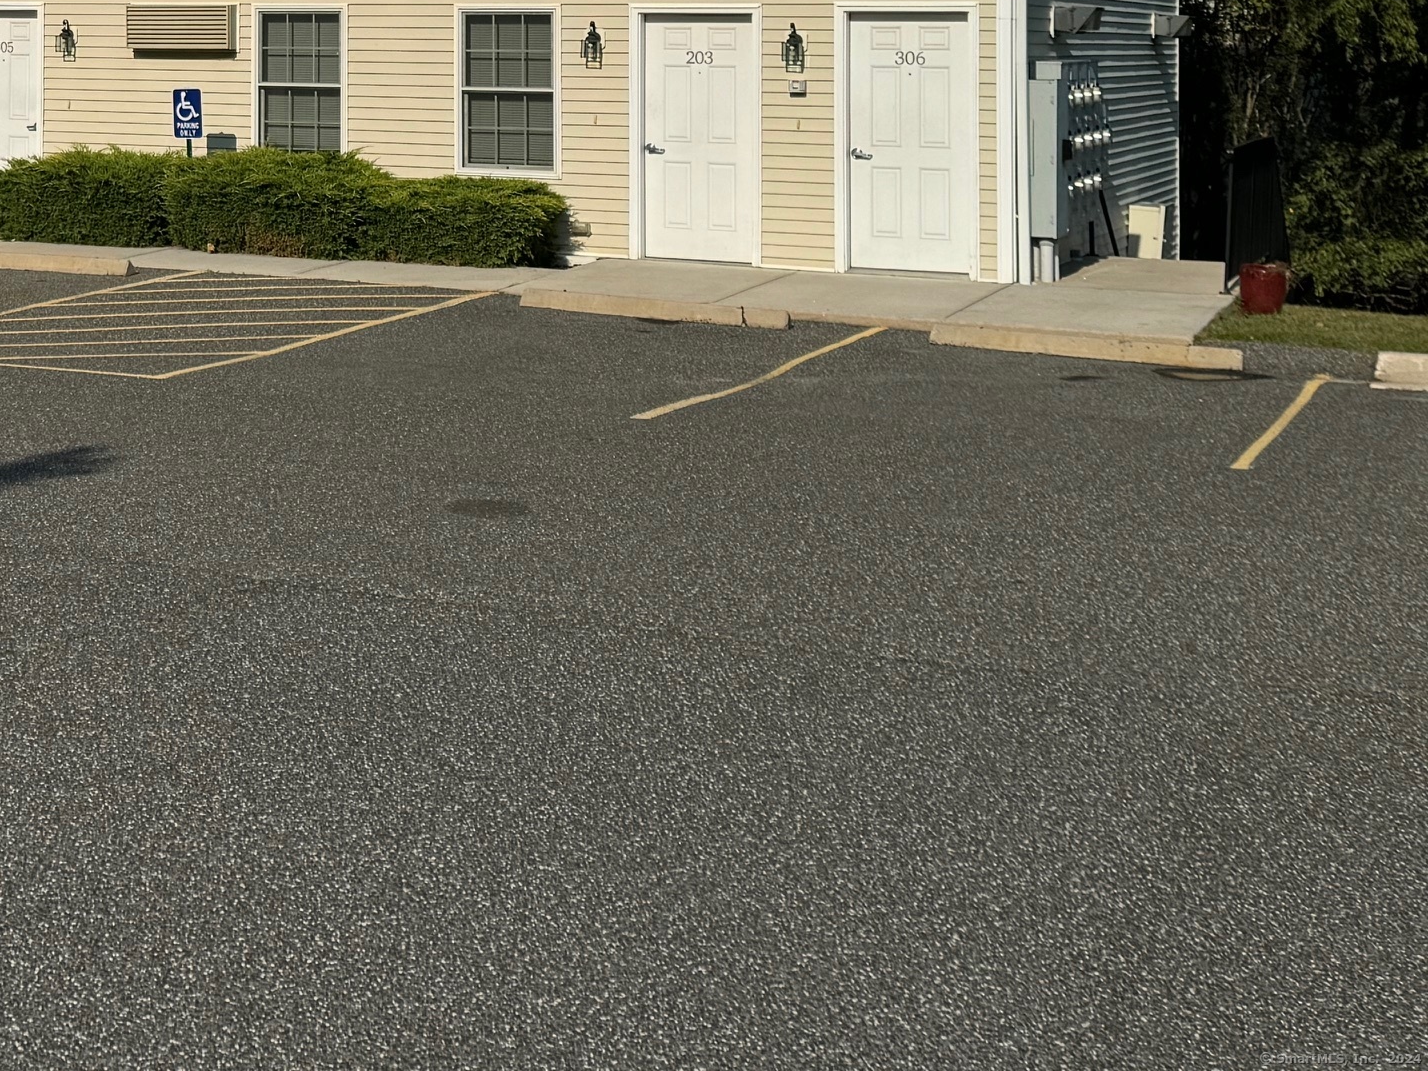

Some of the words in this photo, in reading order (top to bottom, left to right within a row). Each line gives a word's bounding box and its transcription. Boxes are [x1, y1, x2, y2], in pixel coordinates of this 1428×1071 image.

[686, 50, 714, 65] 203
[894, 50, 926, 66] 306
[176, 122, 200, 130] PARKING
